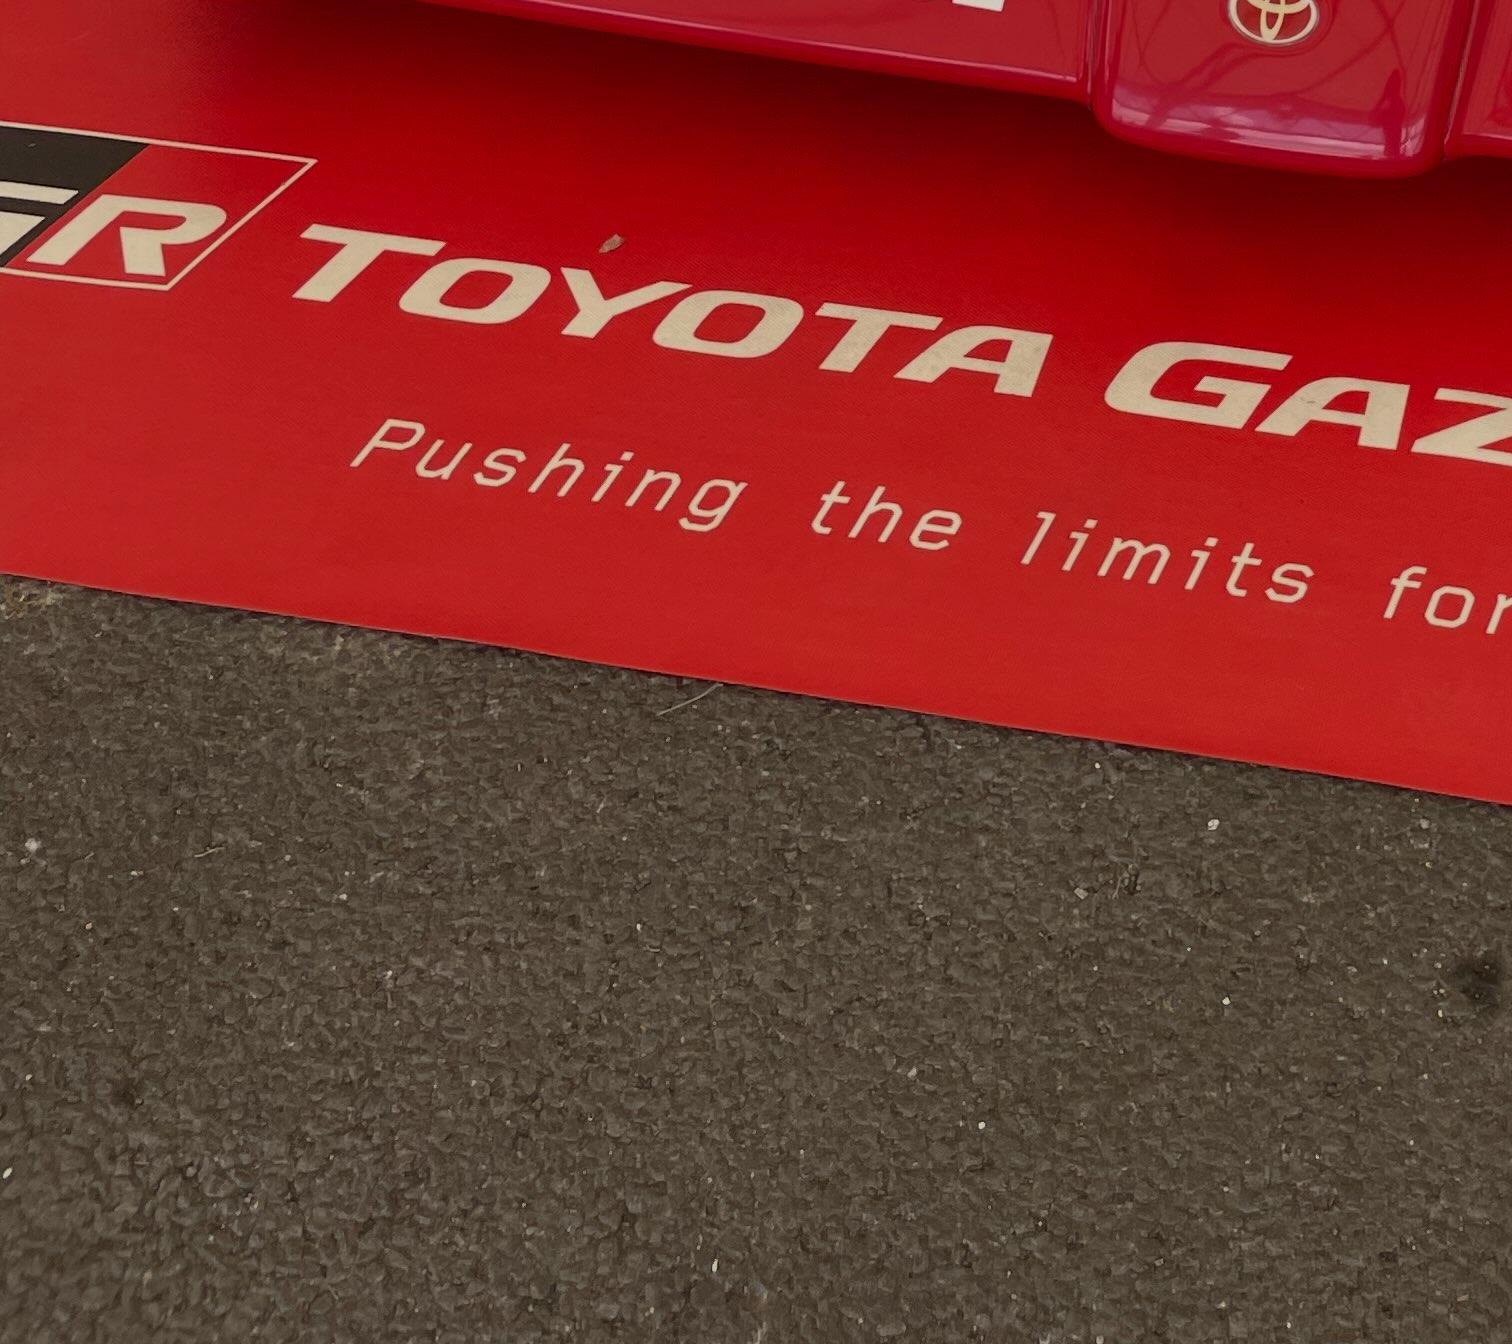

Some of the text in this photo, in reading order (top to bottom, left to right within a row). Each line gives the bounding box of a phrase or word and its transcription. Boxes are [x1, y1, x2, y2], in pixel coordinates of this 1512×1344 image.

[291, 222, 1054, 398] TOYOTA
[348, 417, 748, 533] Pushing
[811, 480, 961, 552] the
[1020, 511, 1315, 604] limits
